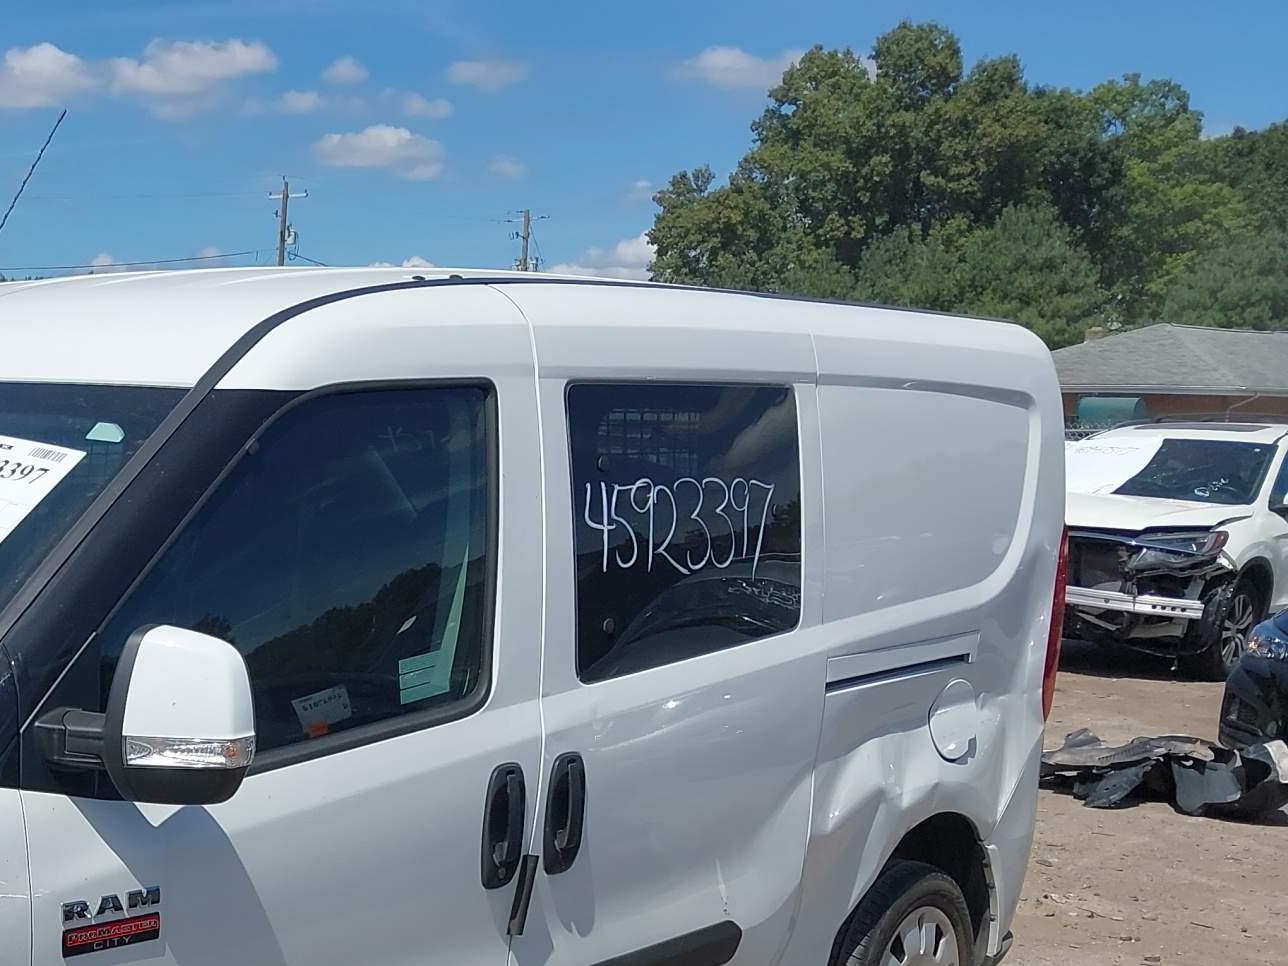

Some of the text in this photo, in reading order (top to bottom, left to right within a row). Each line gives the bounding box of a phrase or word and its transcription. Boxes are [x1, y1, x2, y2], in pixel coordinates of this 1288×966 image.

[584, 477, 776, 582] 45923397
[60, 885, 161, 922] RAM
[93, 935, 133, 950] CITY
